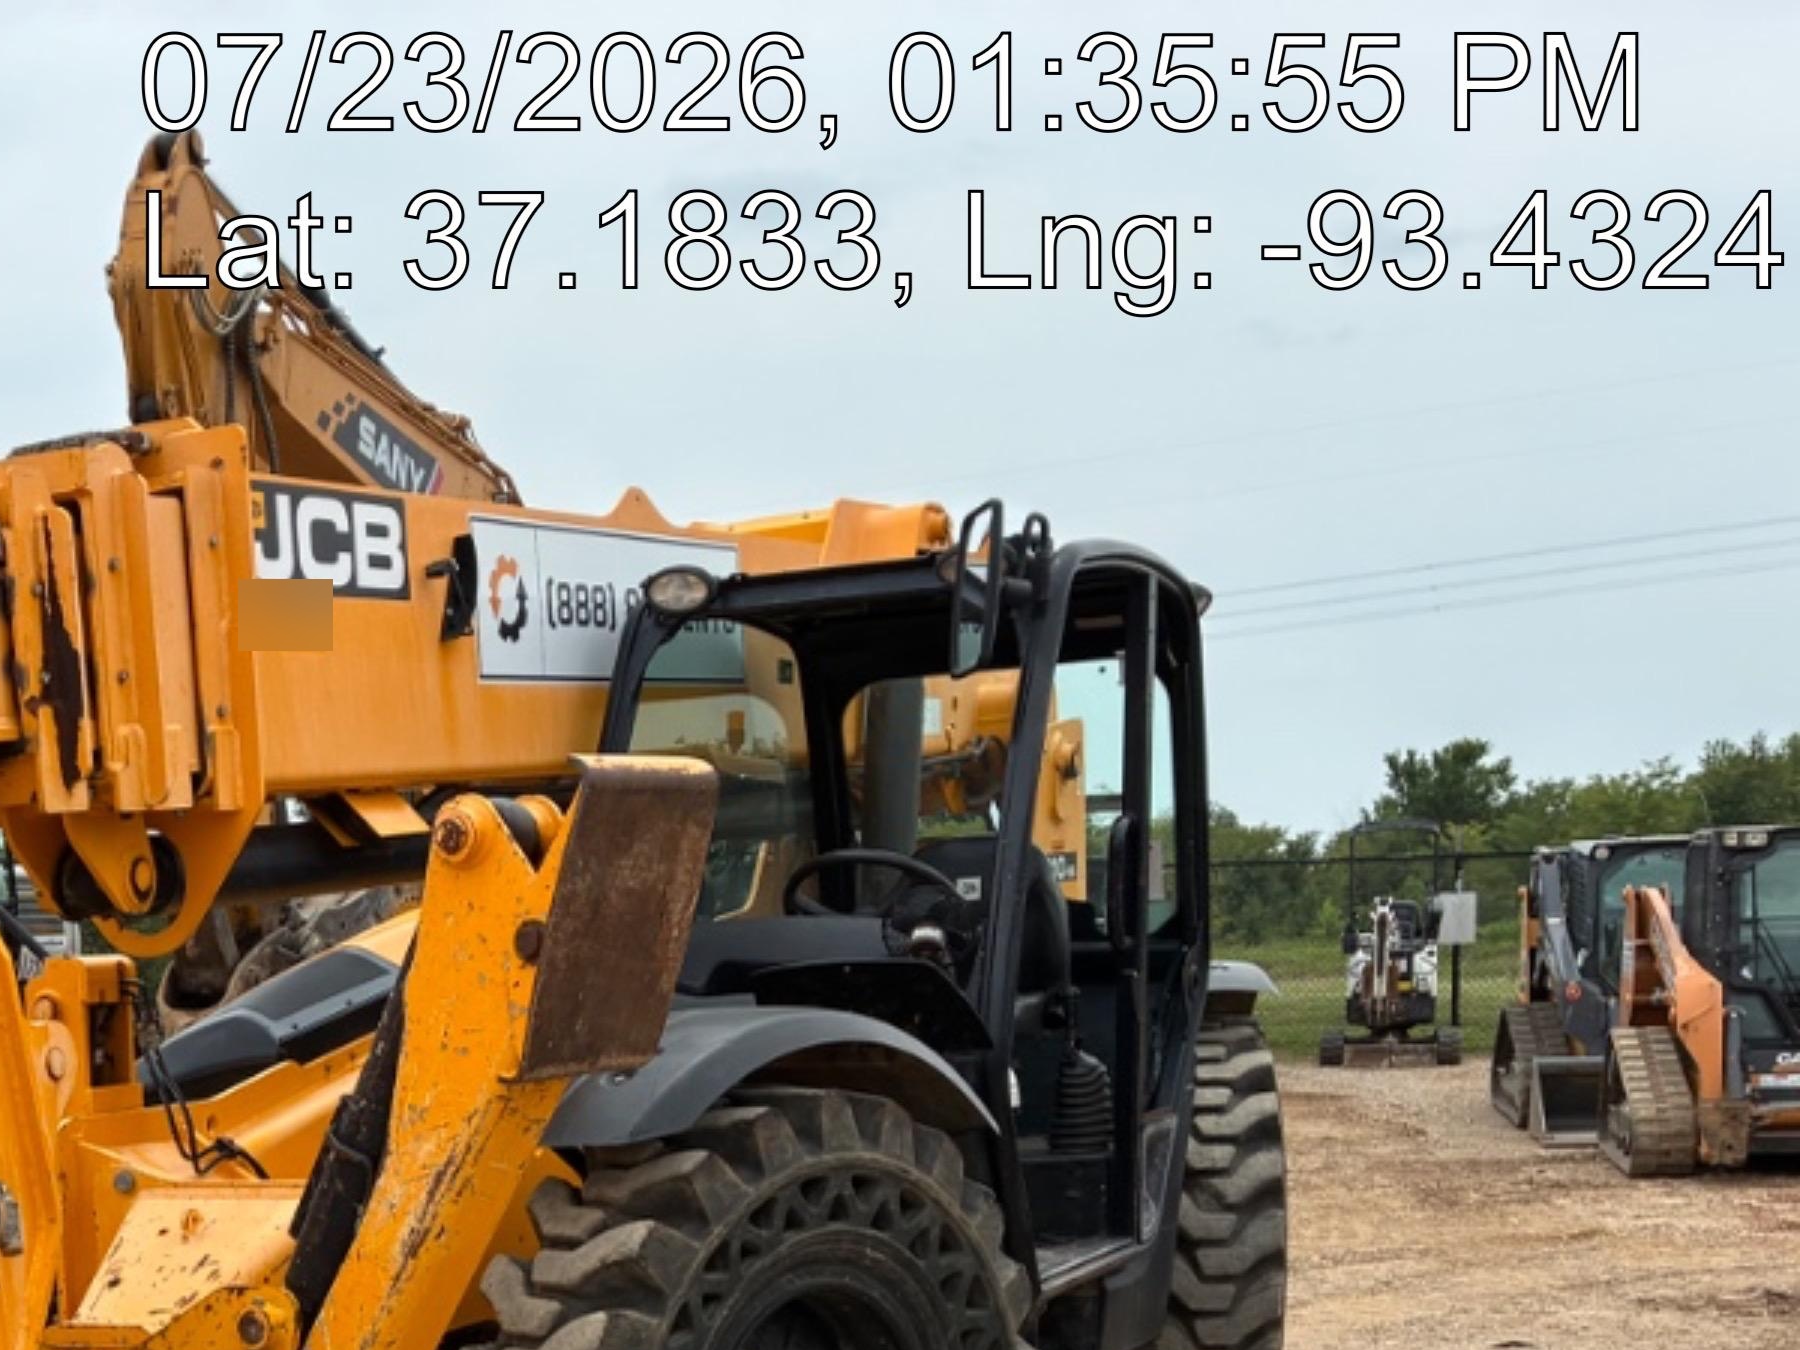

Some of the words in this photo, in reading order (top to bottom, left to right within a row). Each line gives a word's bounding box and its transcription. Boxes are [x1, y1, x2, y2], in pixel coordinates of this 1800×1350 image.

[358, 414, 426, 494] SANY
[254, 493, 406, 589] JCB
[546, 575, 616, 632] (888)
